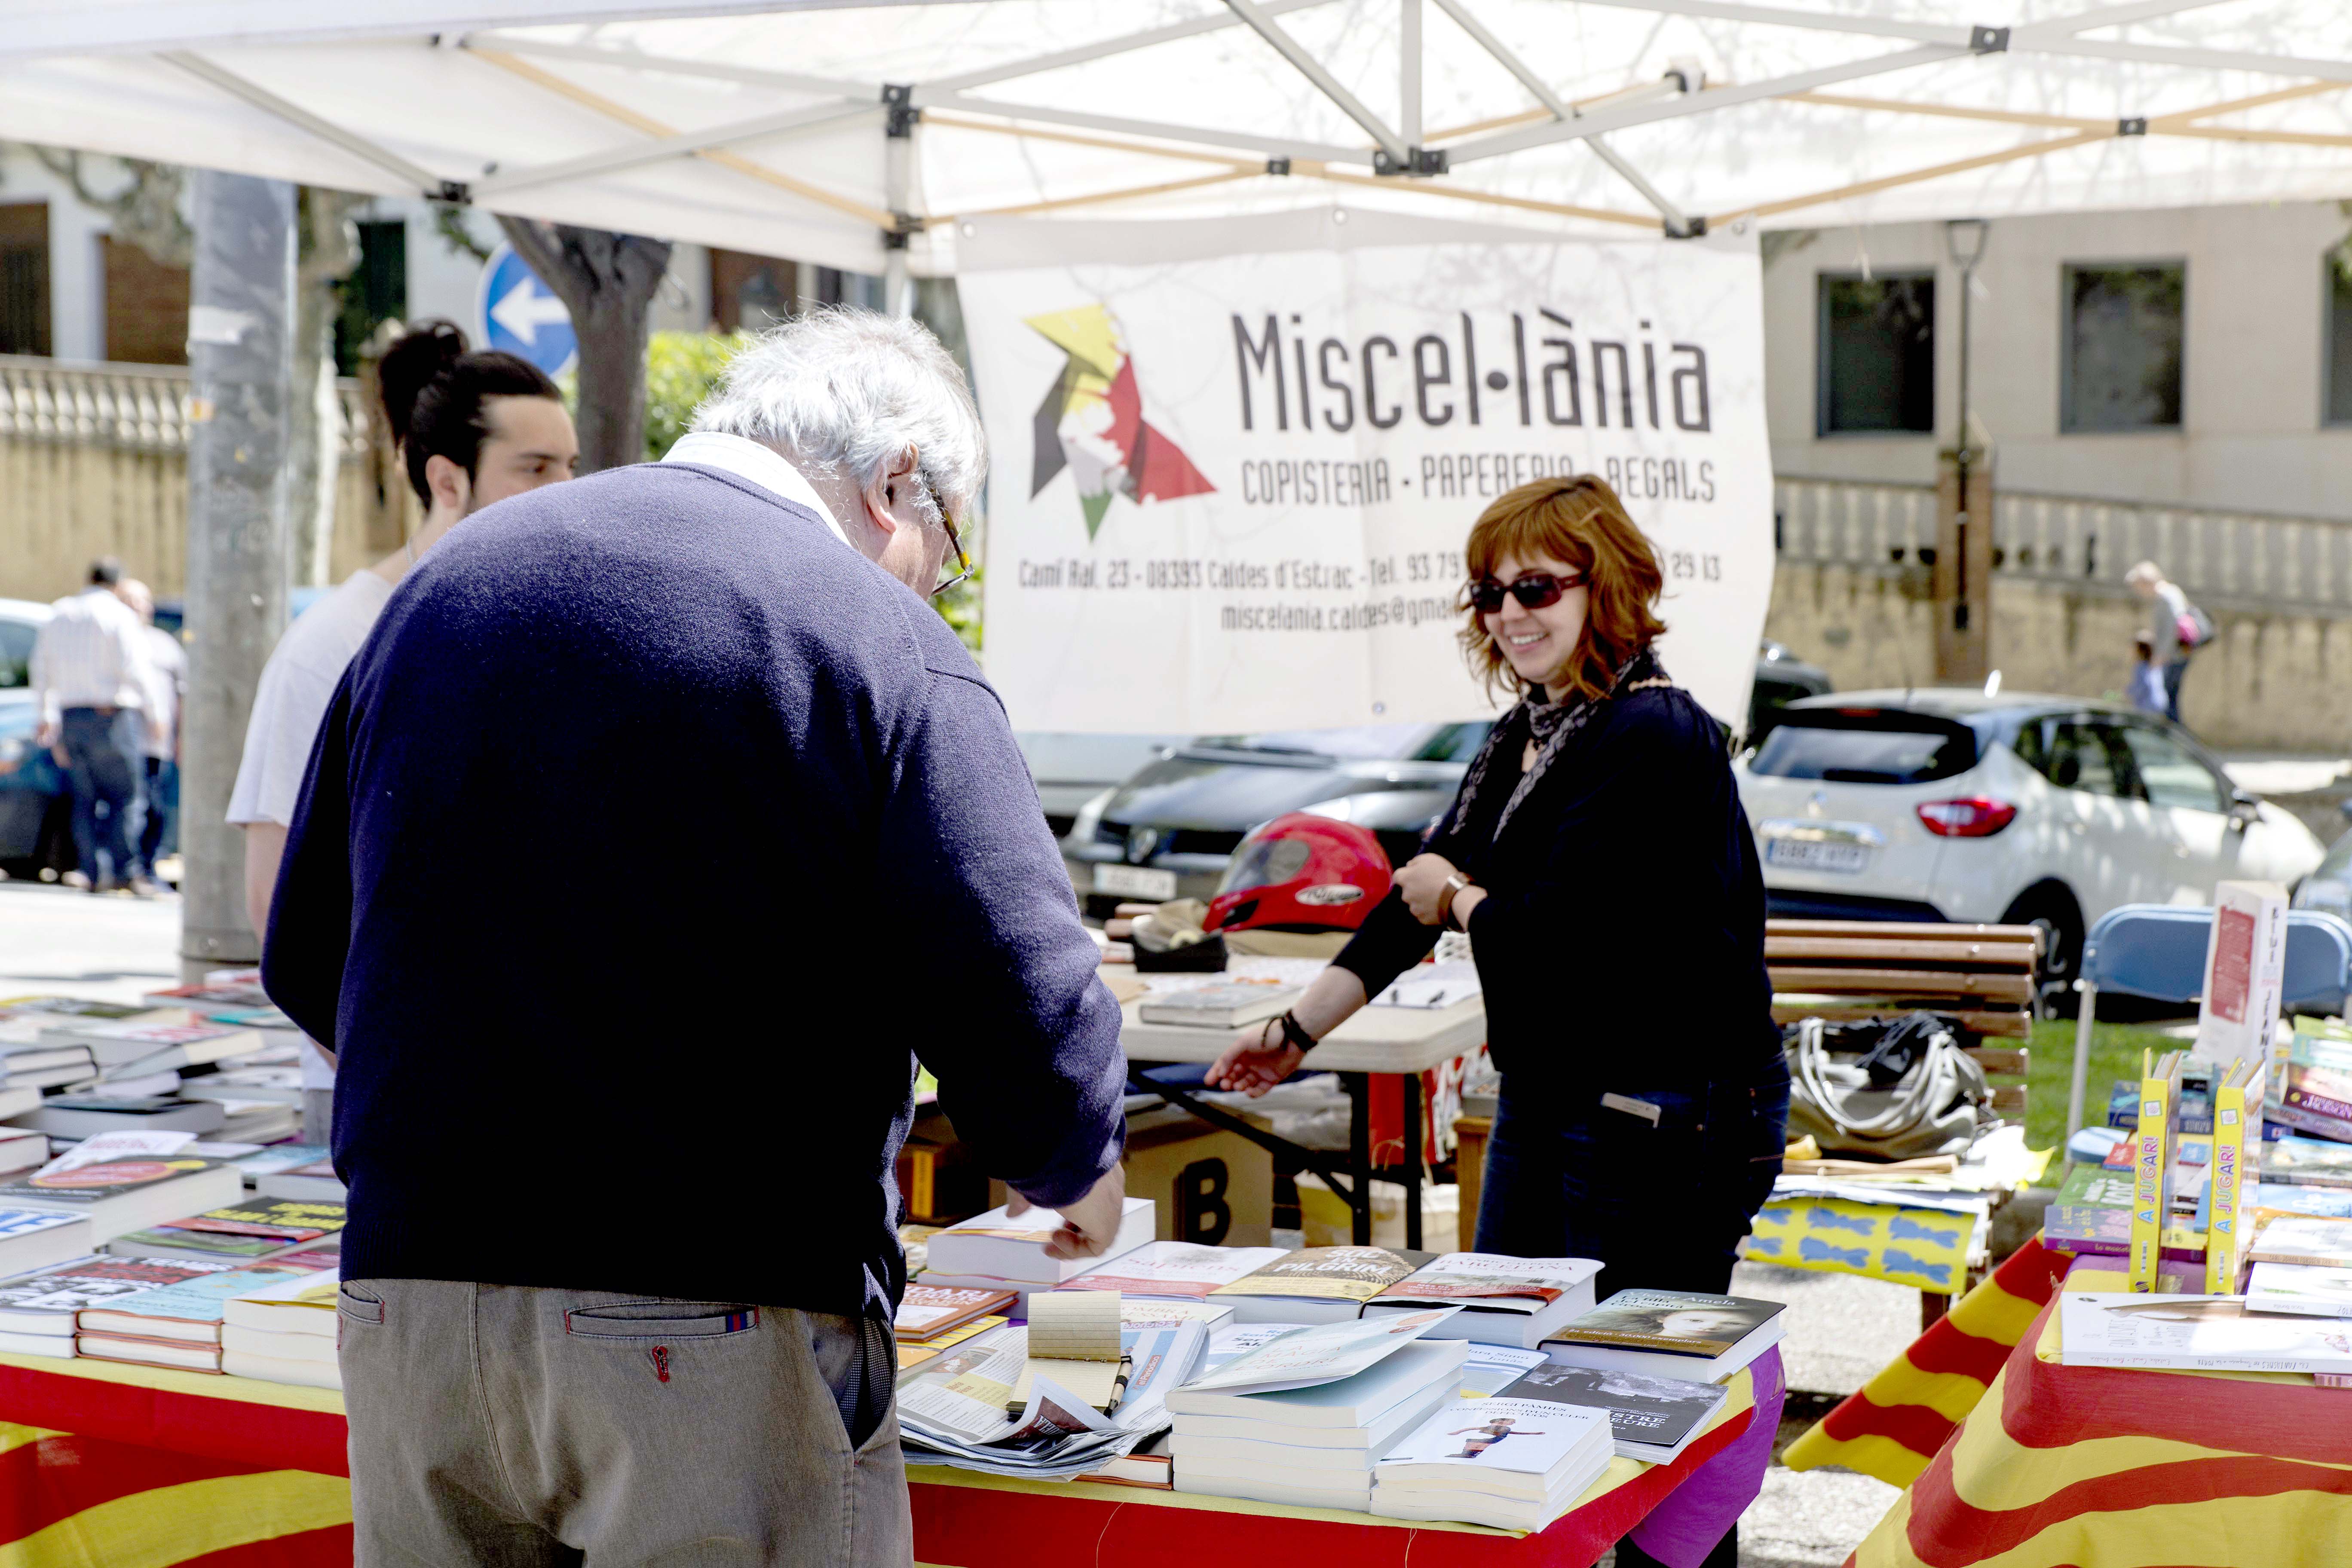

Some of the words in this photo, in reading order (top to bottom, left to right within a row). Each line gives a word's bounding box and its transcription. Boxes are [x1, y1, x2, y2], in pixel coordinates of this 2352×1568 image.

[1242, 459, 1392, 505] COPISTERIA
[1606, 456, 1715, 502] REGALS
[1107, 560, 1129, 589] 23
[1208, 560, 1269, 590] Caldes
[1407, 552, 1430, 582] 93
[1436, 550, 1461, 580] 79
[2138, 1135, 2160, 1204] JUGAR!
[2216, 1145, 2236, 1213] JUGAR!
[1273, 1262, 1393, 1274] PILGRIM
[1682, 1296, 1736, 1305] Amela
[1610, 1412, 1666, 1424] STRE
[1610, 1418, 1661, 1428] EURE
